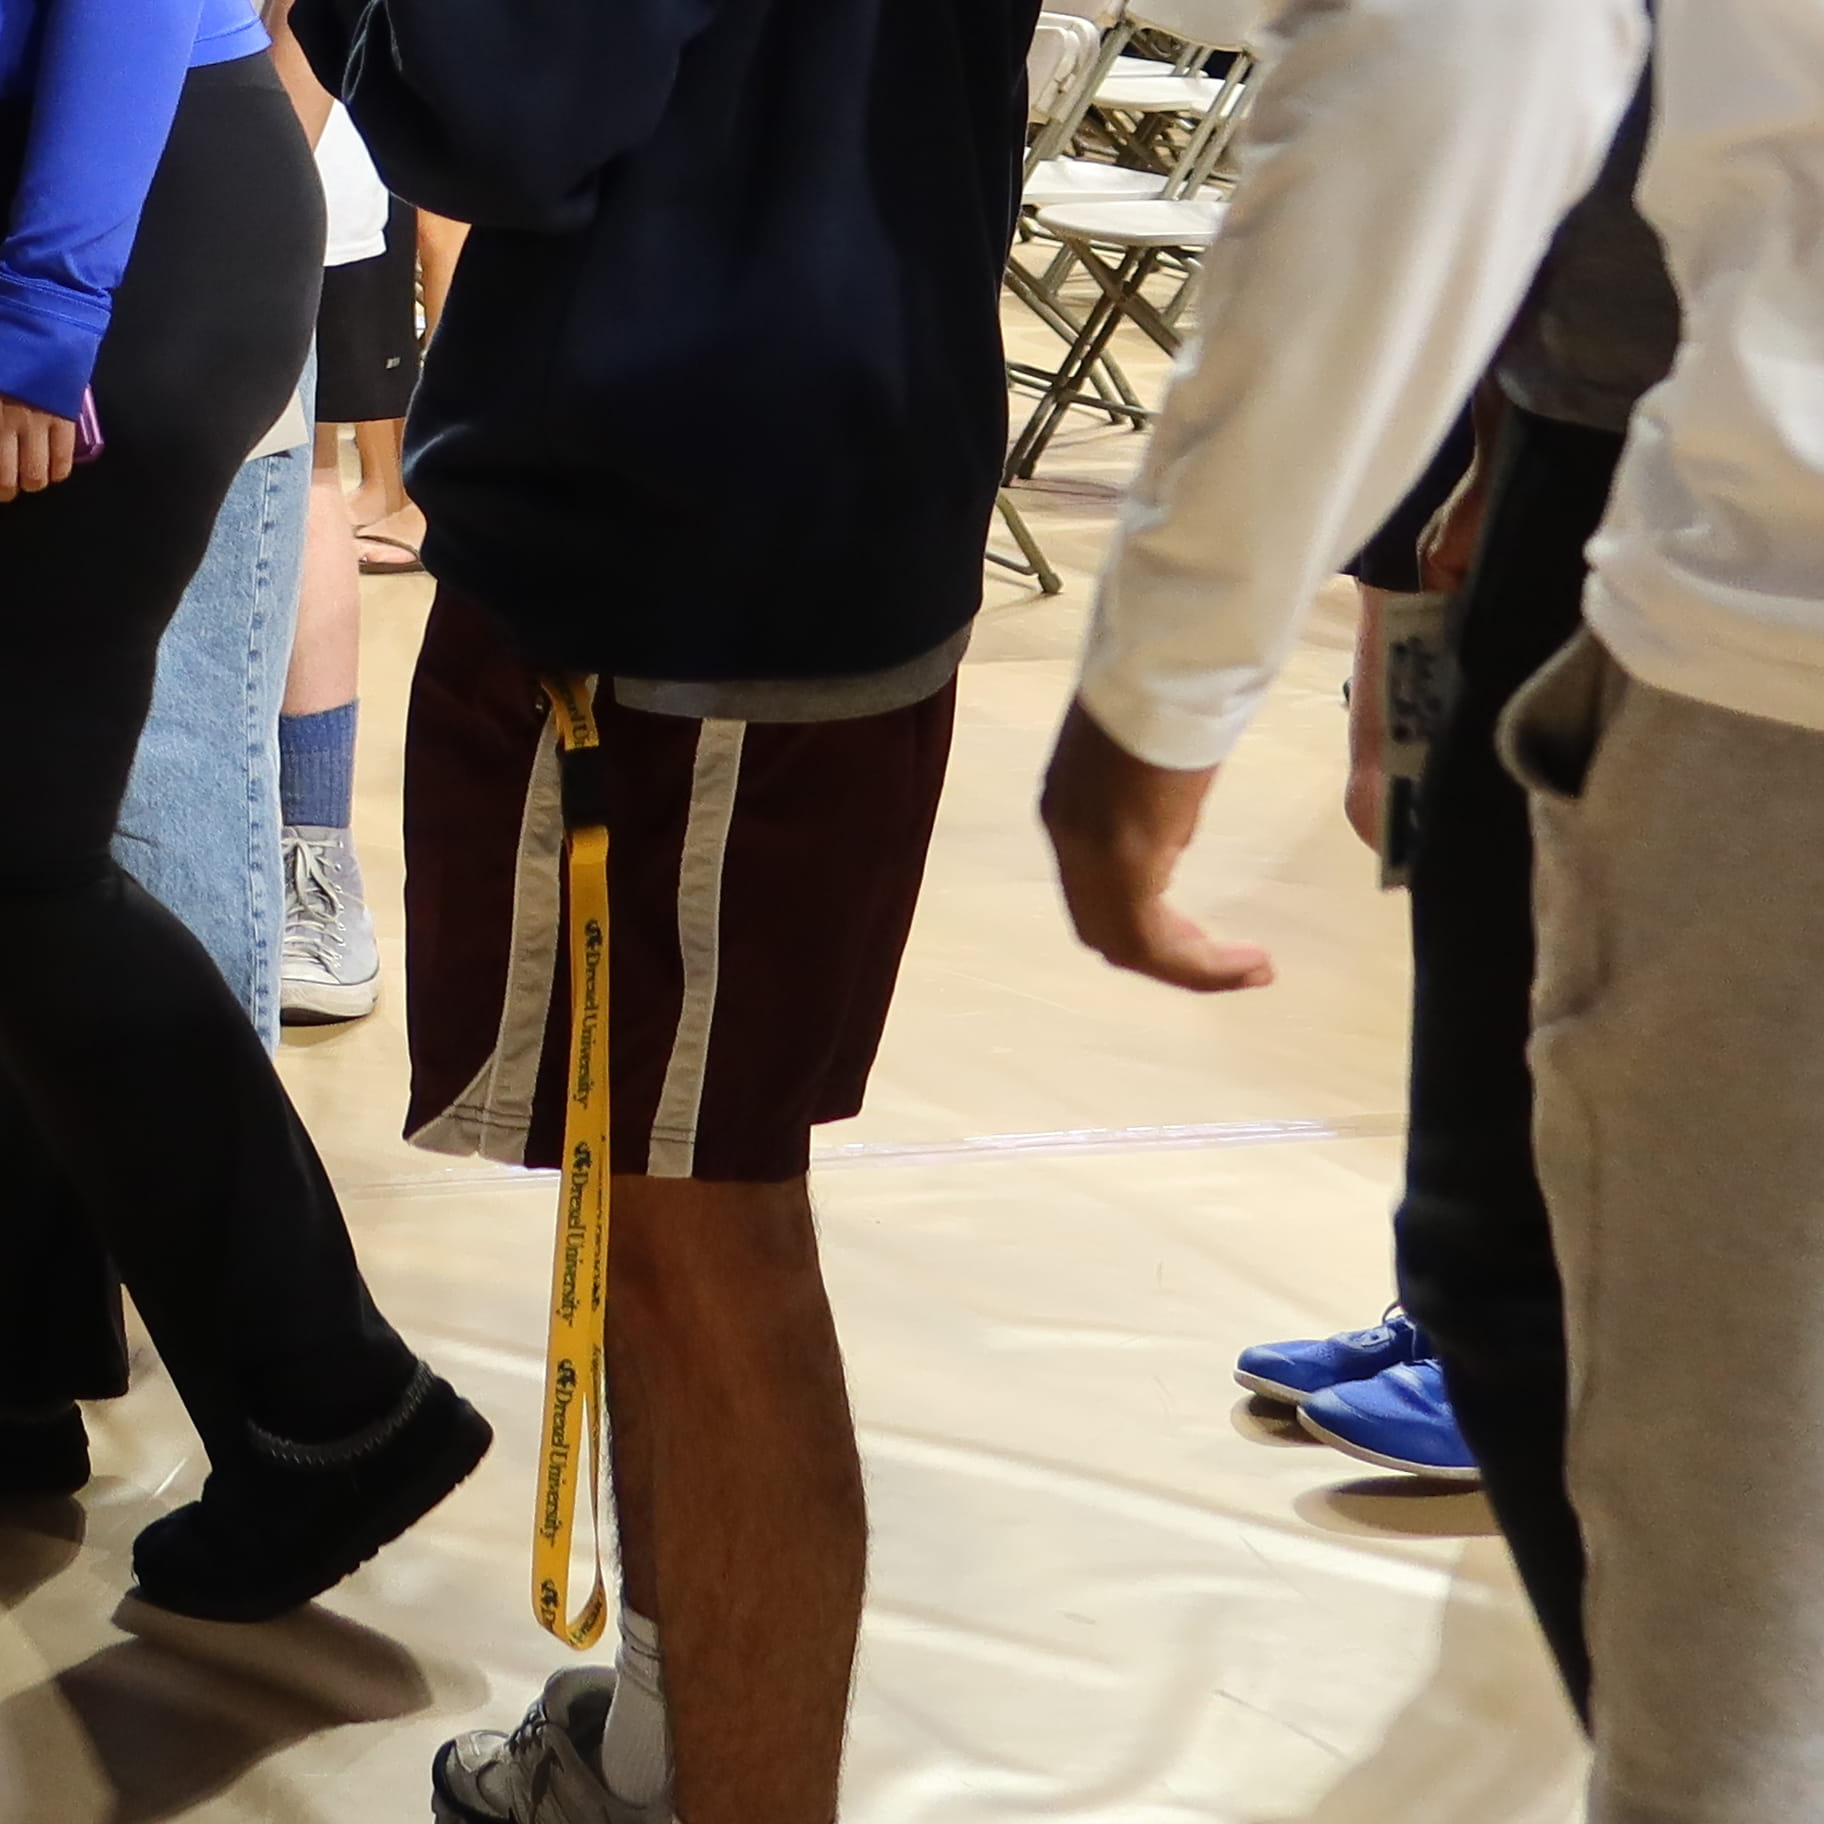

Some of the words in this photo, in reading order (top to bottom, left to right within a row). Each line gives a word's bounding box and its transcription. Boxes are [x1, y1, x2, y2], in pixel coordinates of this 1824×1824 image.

[584, 950, 600, 1013] Drexel
[571, 1015, 596, 1109] University
[568, 1173, 589, 1229] Drexel
[557, 1230, 585, 1326] University
[552, 1389, 575, 1443] Drexel
[539, 1443, 570, 1547] University
